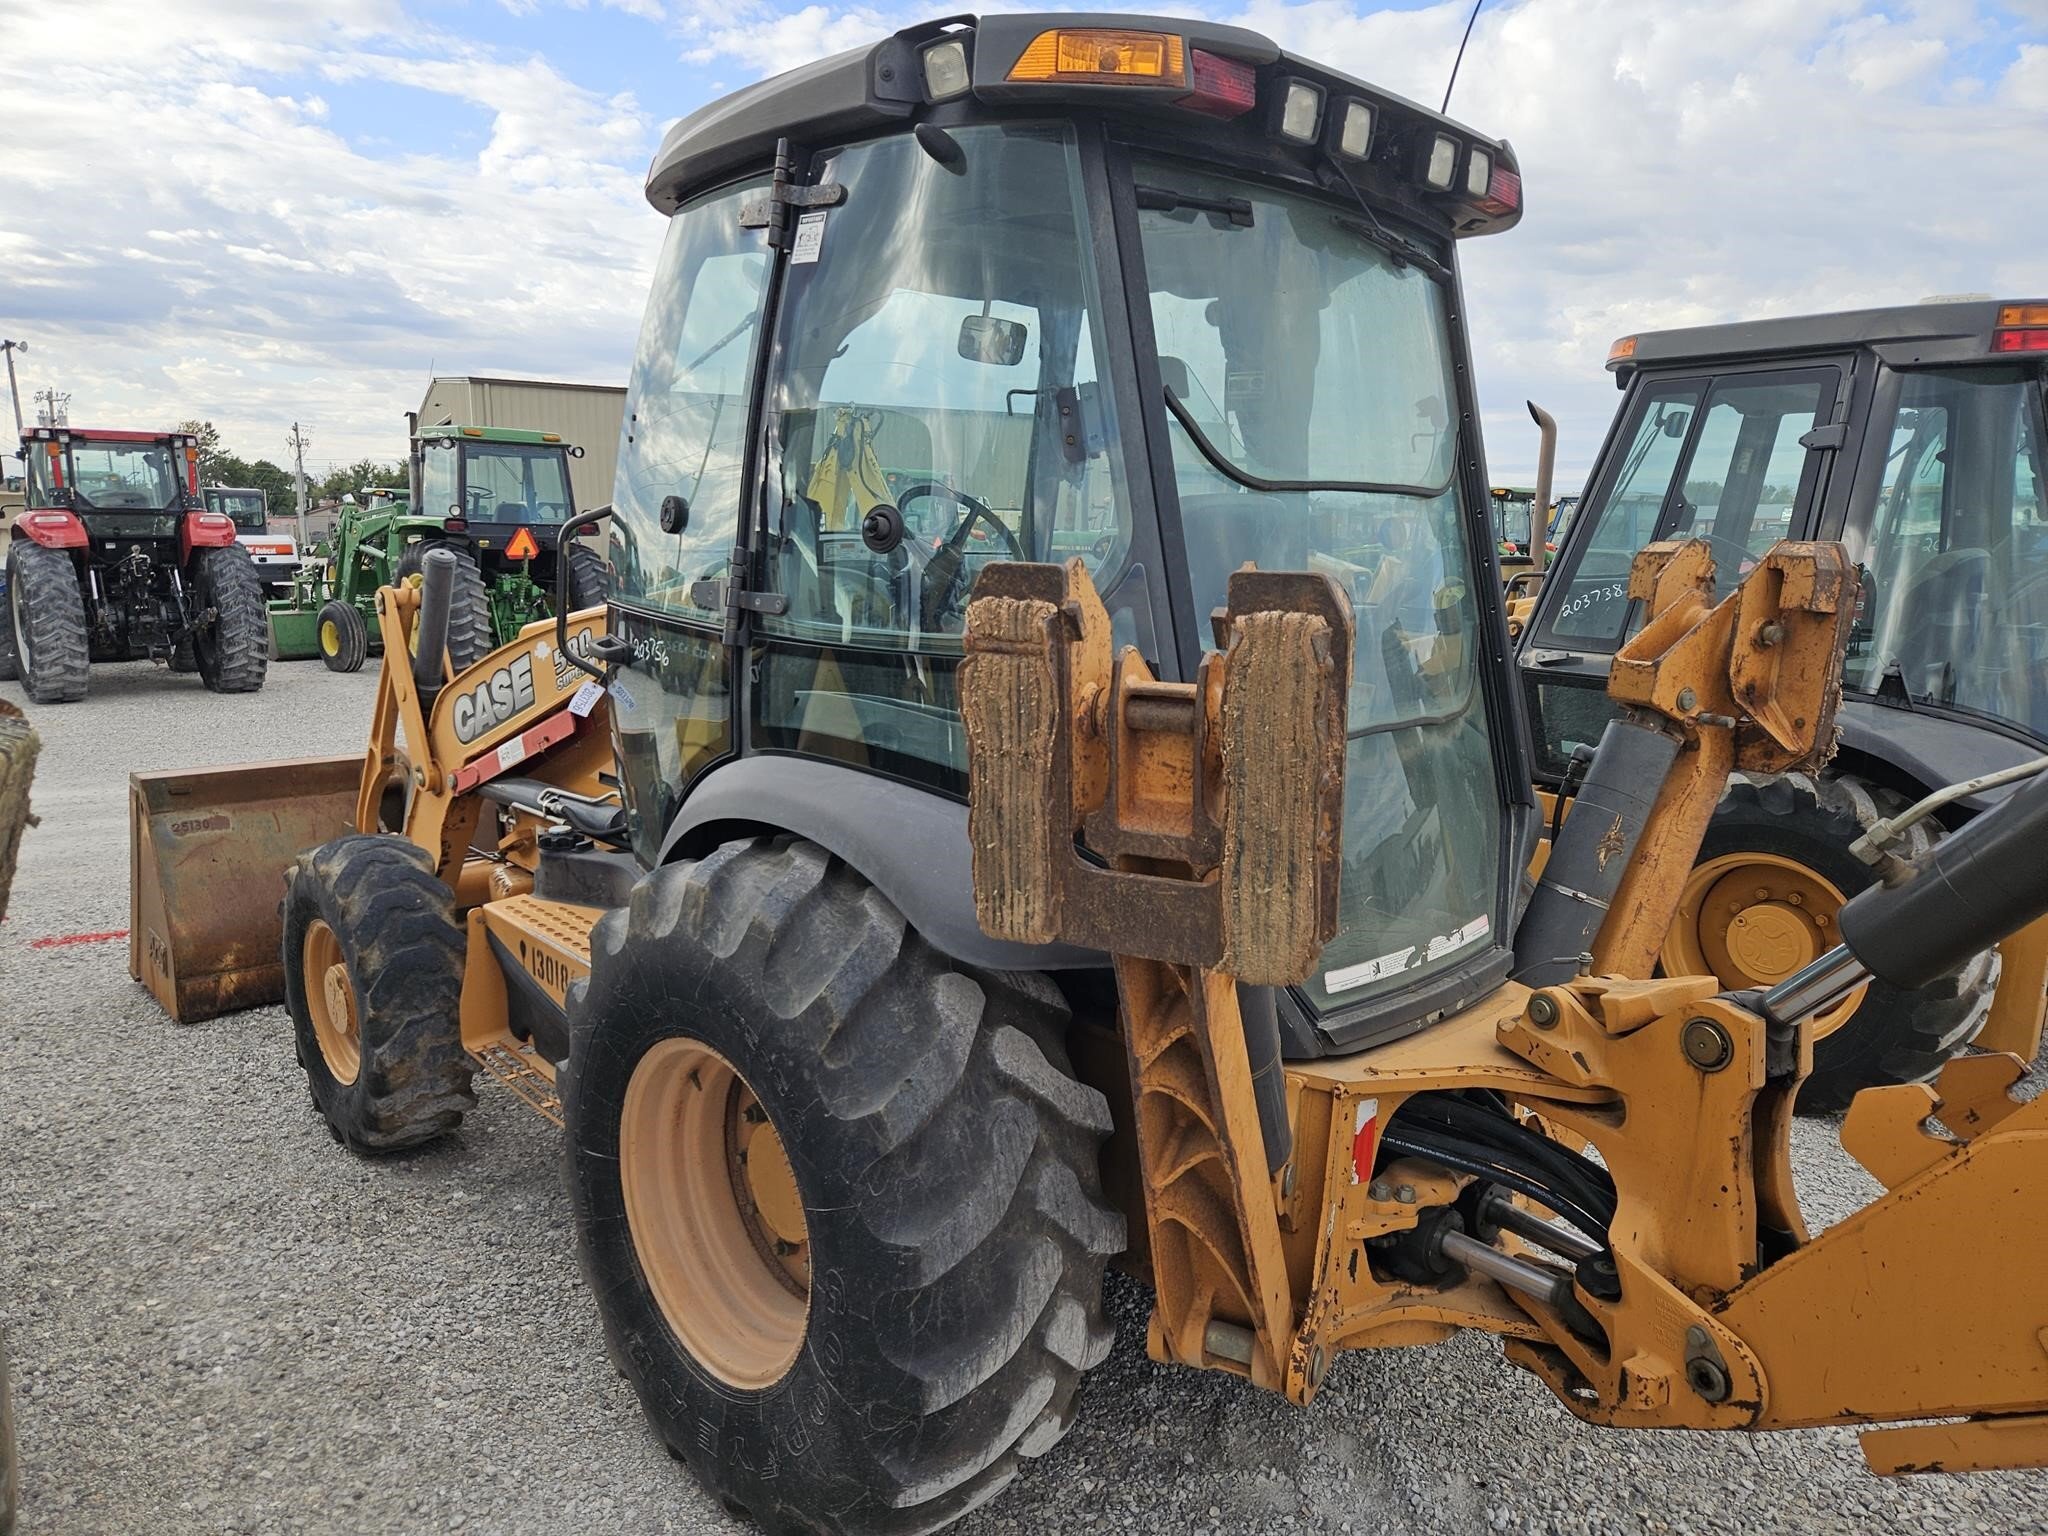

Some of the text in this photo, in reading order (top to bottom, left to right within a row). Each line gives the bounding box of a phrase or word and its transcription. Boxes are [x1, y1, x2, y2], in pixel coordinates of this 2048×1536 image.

[1562, 583, 1623, 617] 203738
[633, 636, 669, 667] 203756
[556, 667, 586, 691] SUPE
[453, 650, 535, 745] CASE
